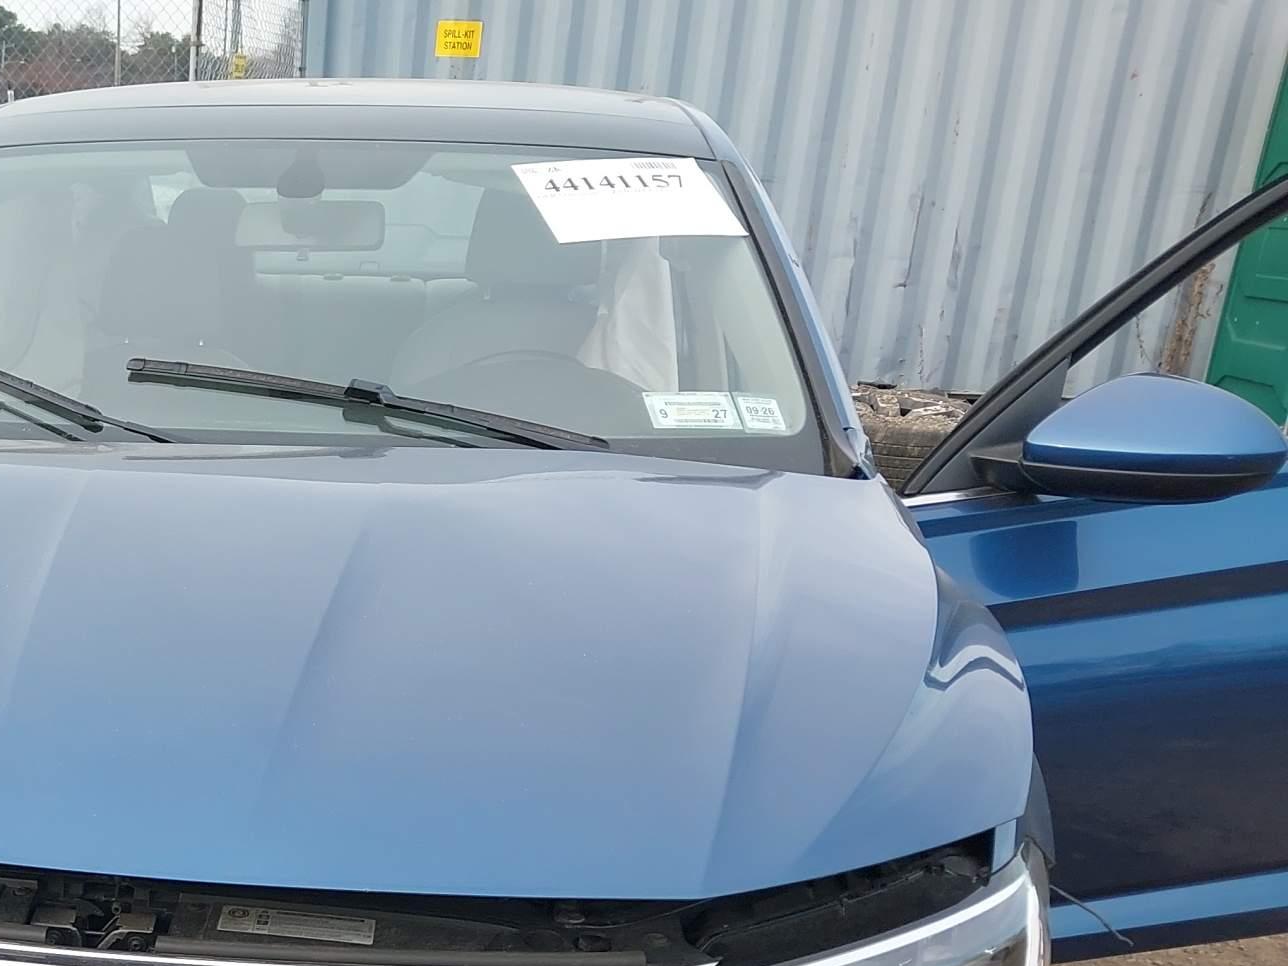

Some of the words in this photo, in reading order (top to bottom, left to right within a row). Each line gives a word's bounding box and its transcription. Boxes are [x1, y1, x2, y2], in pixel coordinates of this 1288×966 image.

[443, 29, 475, 39] SPILL-KIT
[443, 41, 473, 50] STATION
[544, 174, 683, 192] 44141157
[659, 408, 669, 419] 9
[712, 409, 728, 419] 27
